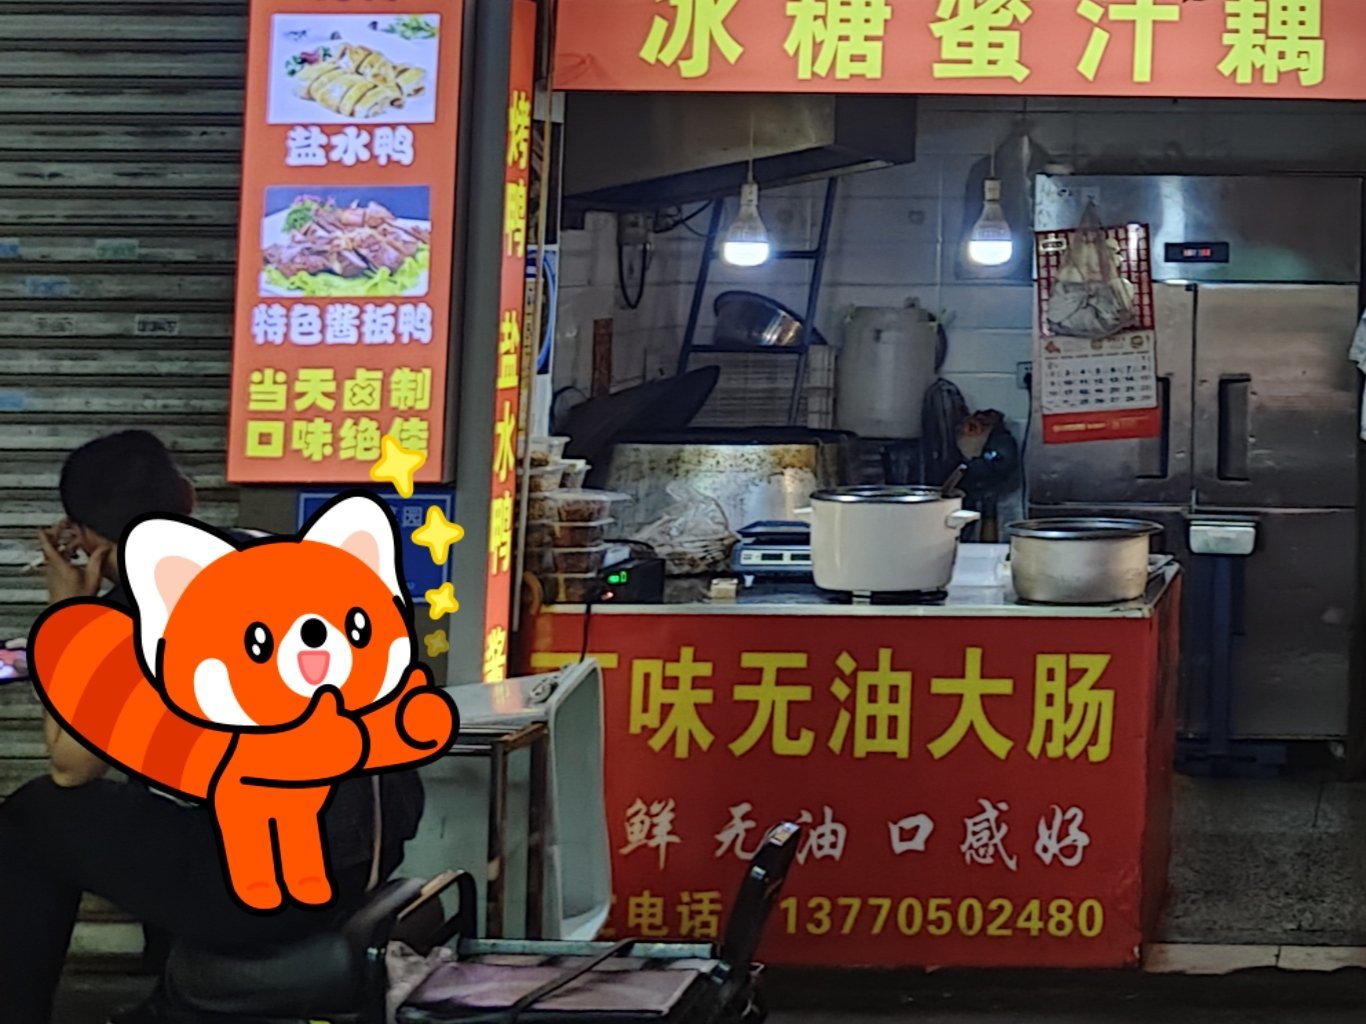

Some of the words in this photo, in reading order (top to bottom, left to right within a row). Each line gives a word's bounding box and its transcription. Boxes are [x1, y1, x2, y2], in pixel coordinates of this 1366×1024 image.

[285, 125, 415, 167] 盐水鸭
[250, 303, 433, 346] 特色酱板鸭
[247, 367, 432, 412] 当天卤制
[529, 645, 1116, 763] 味无油大肠
[779, 896, 1106, 939] 13770502480
